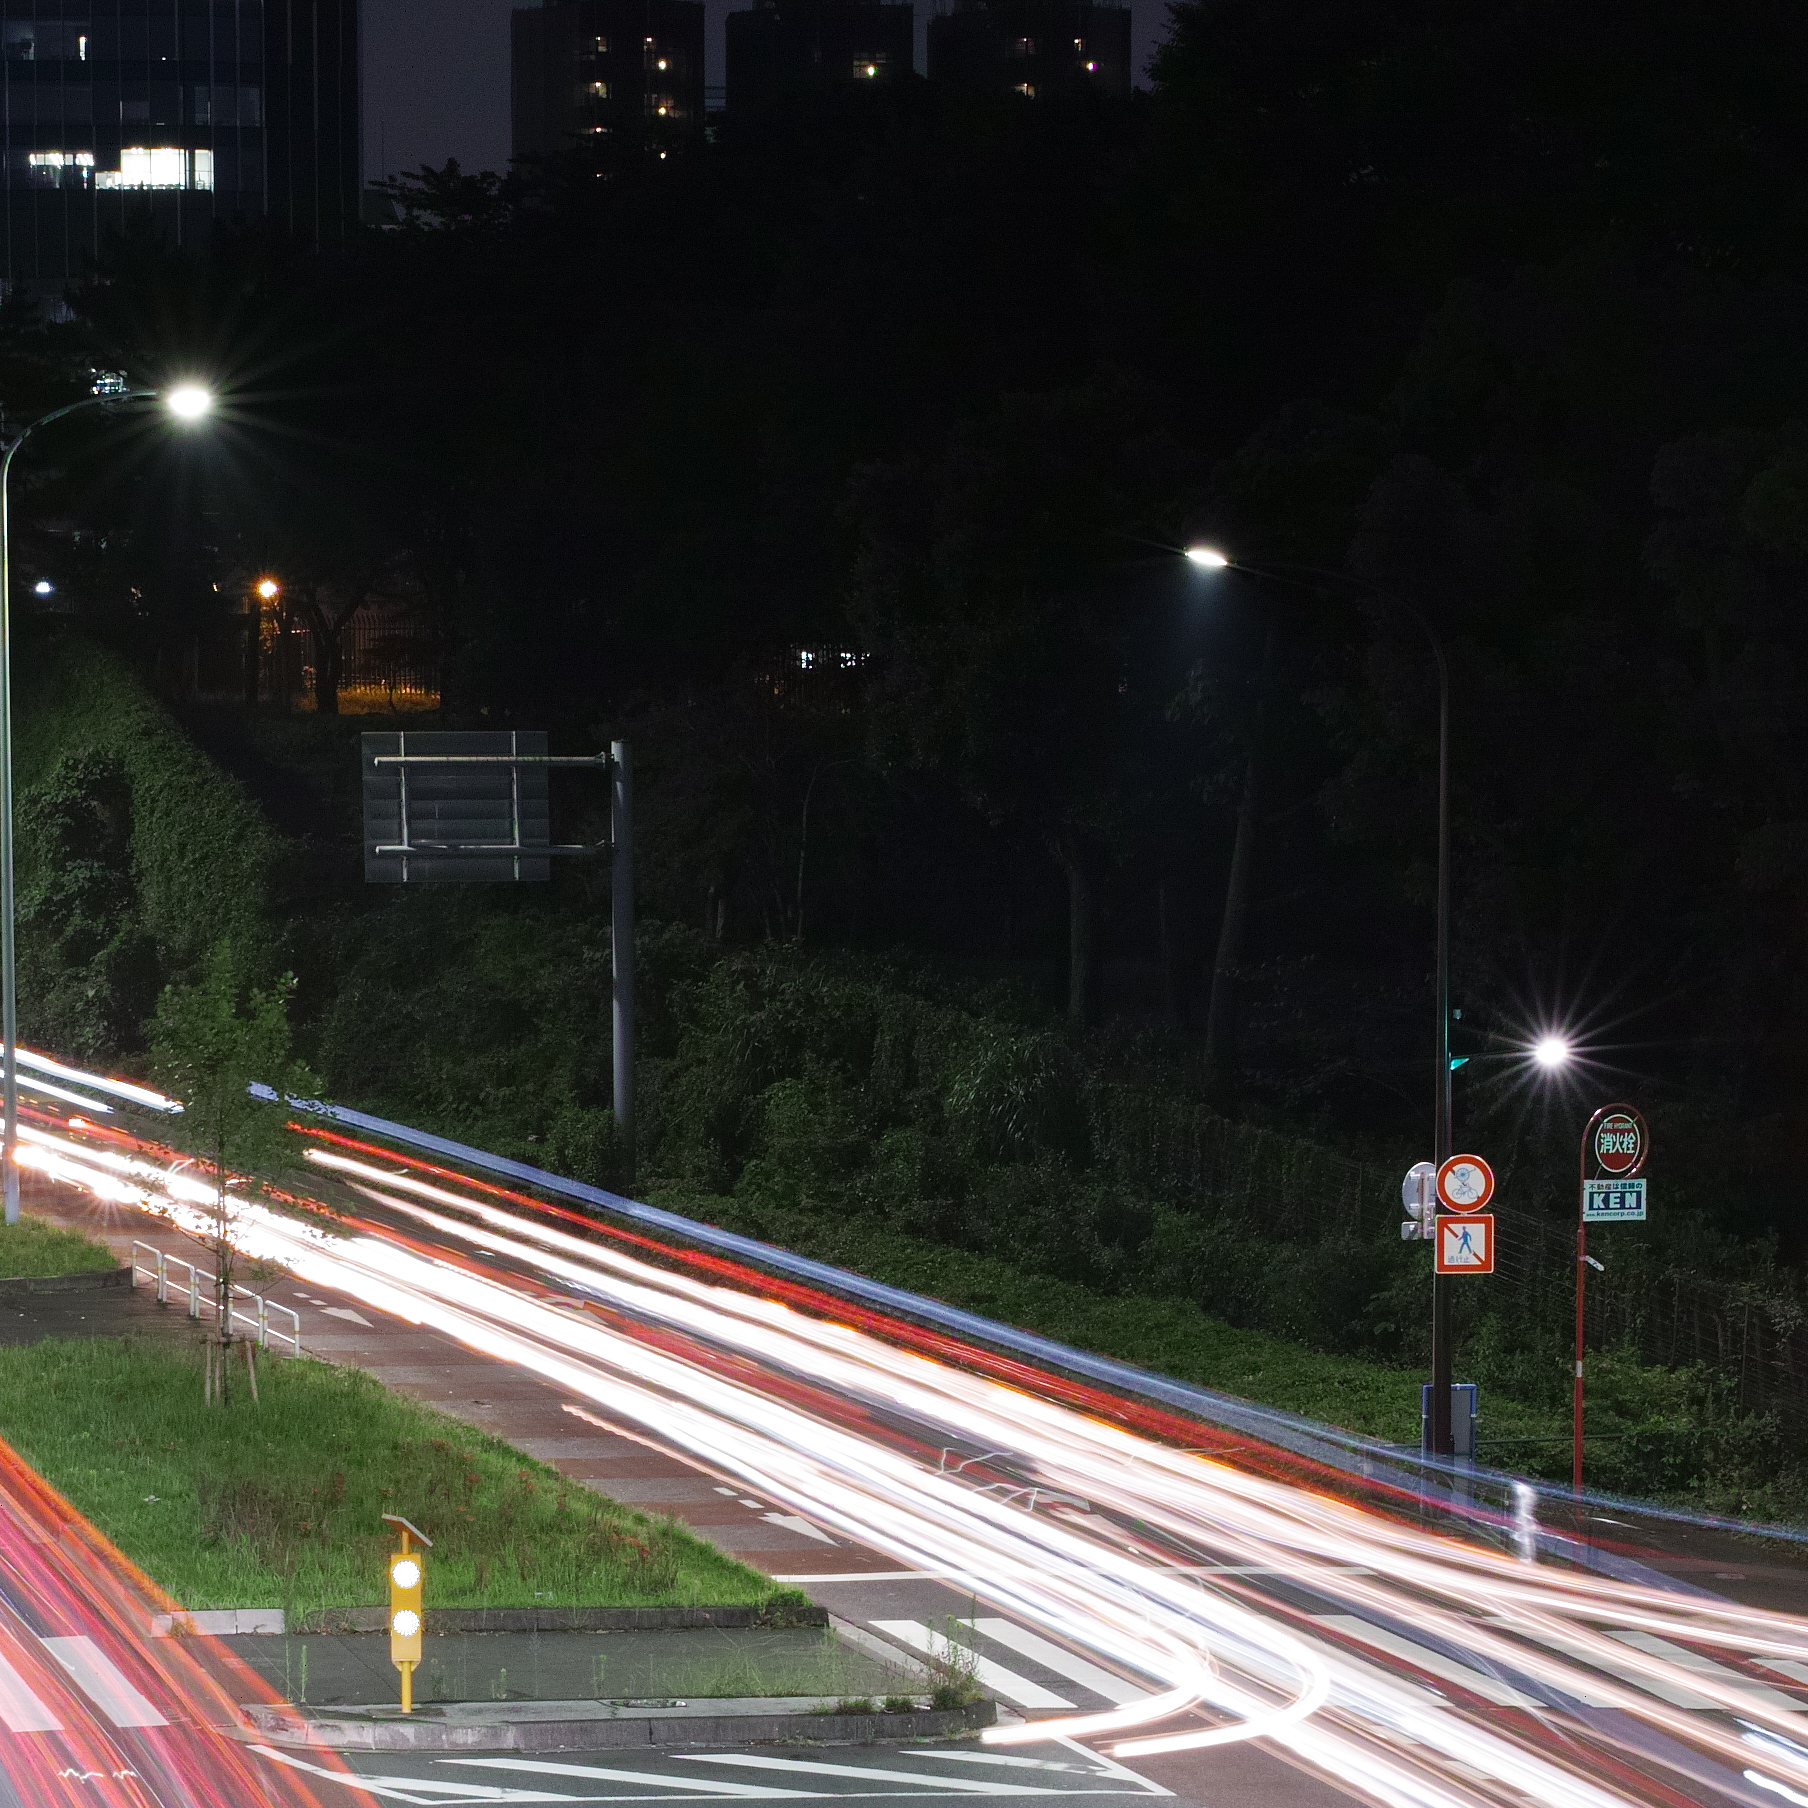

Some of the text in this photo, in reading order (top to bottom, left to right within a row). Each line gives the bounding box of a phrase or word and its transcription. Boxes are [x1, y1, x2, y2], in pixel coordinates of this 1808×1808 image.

[1599, 1132, 1636, 1154] 消火栓
[1592, 1192, 1637, 1209] KEN
